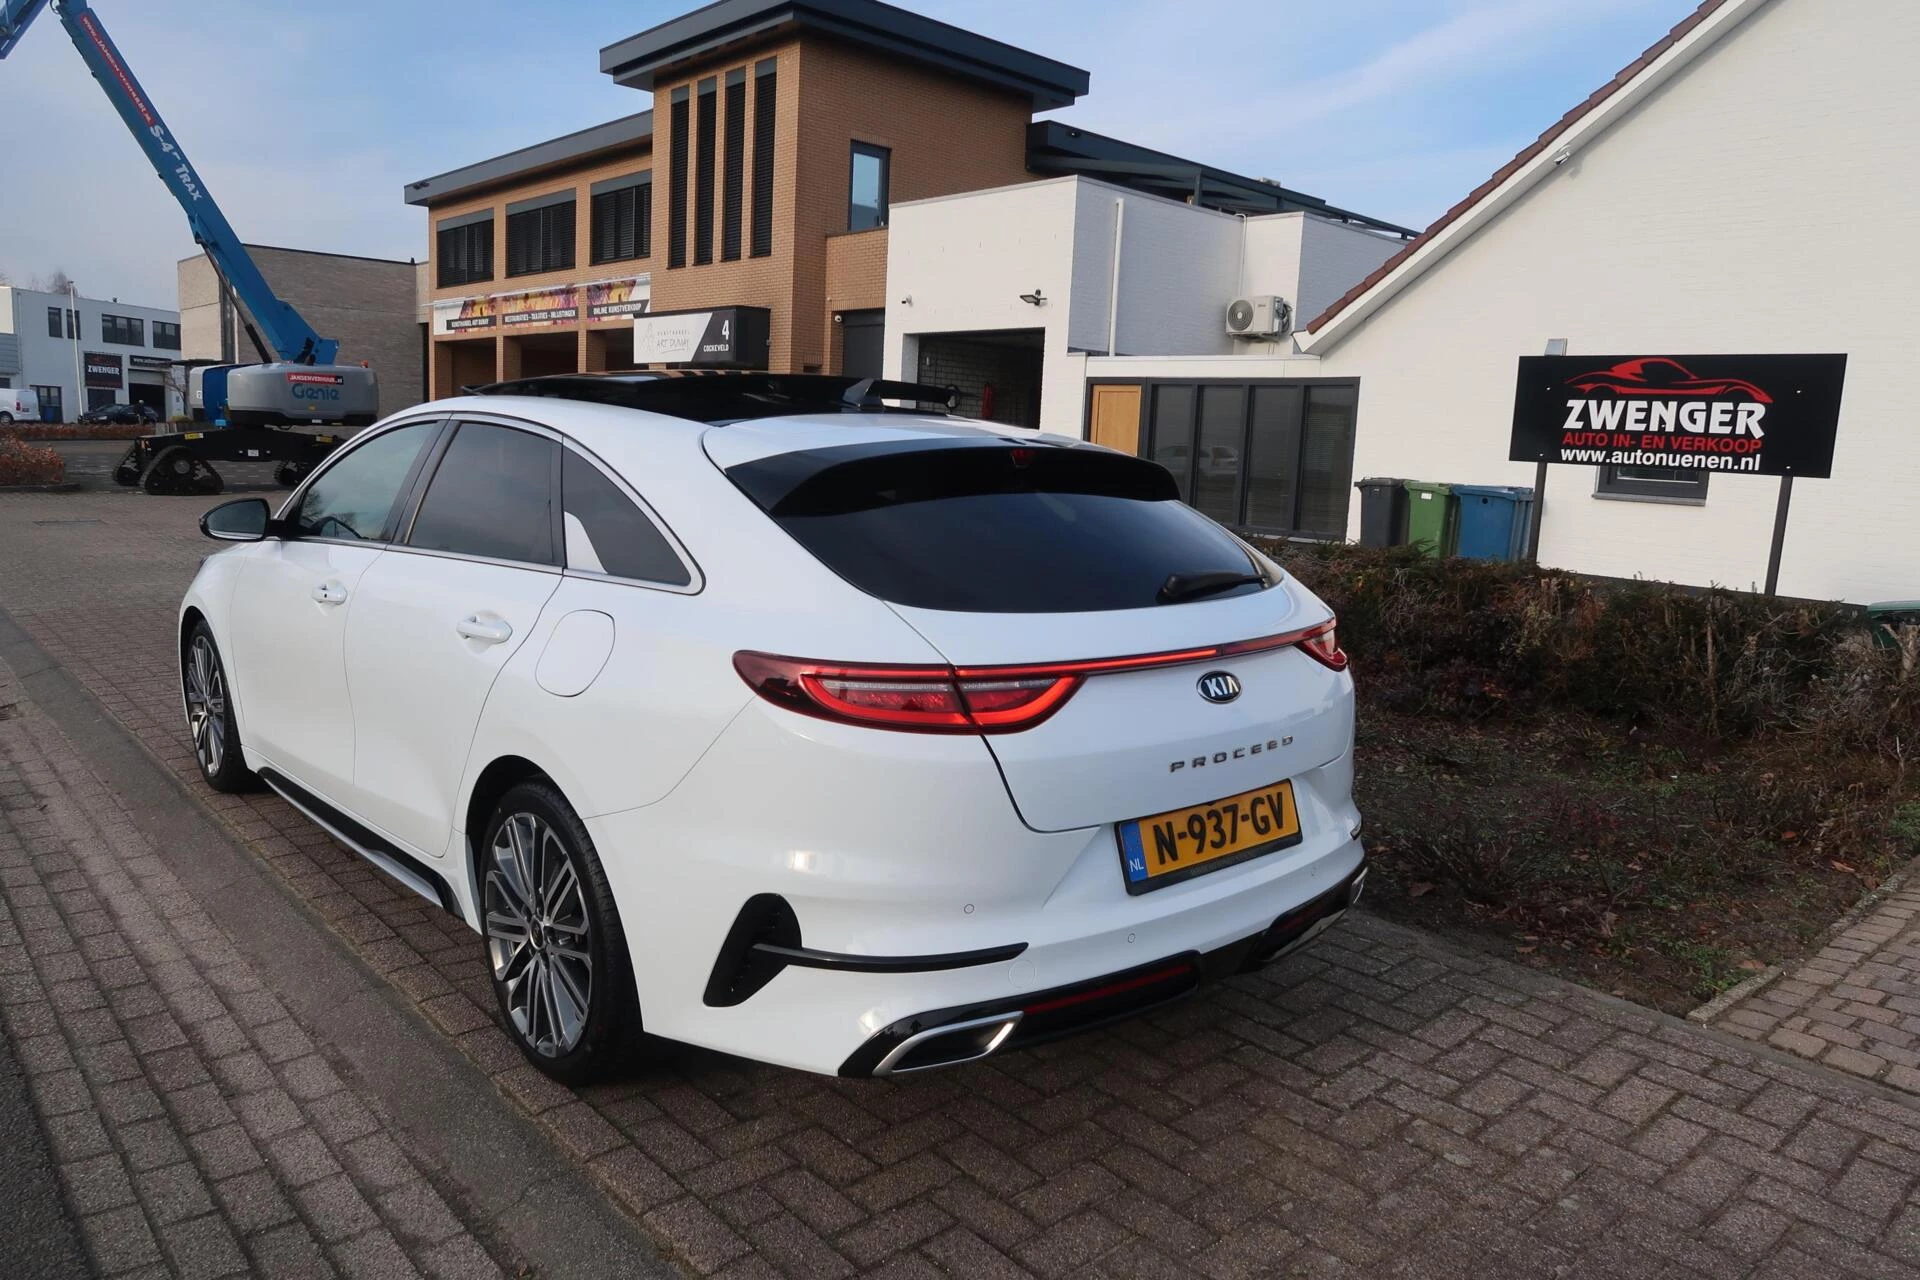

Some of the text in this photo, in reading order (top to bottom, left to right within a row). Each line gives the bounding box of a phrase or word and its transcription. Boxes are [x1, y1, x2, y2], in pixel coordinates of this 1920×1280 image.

[608, 302, 642, 314] KUNSTVERKOOP
[721, 319, 730, 341] 4
[703, 344, 730, 353] COCKEVELD
[87, 364, 120, 376] ZWENGER
[291, 383, 340, 401] Genie
[1562, 399, 1767, 440] ZWENGER
[1562, 431, 1763, 454] AUTO IN- EN VERKOOP
[1560, 448, 1761, 471] www.autonuenen.nl
[1206, 675, 1239, 698] KIA
[1169, 735, 1294, 773] PROCEED
[1129, 791, 1284, 872] NL N-937-GV
